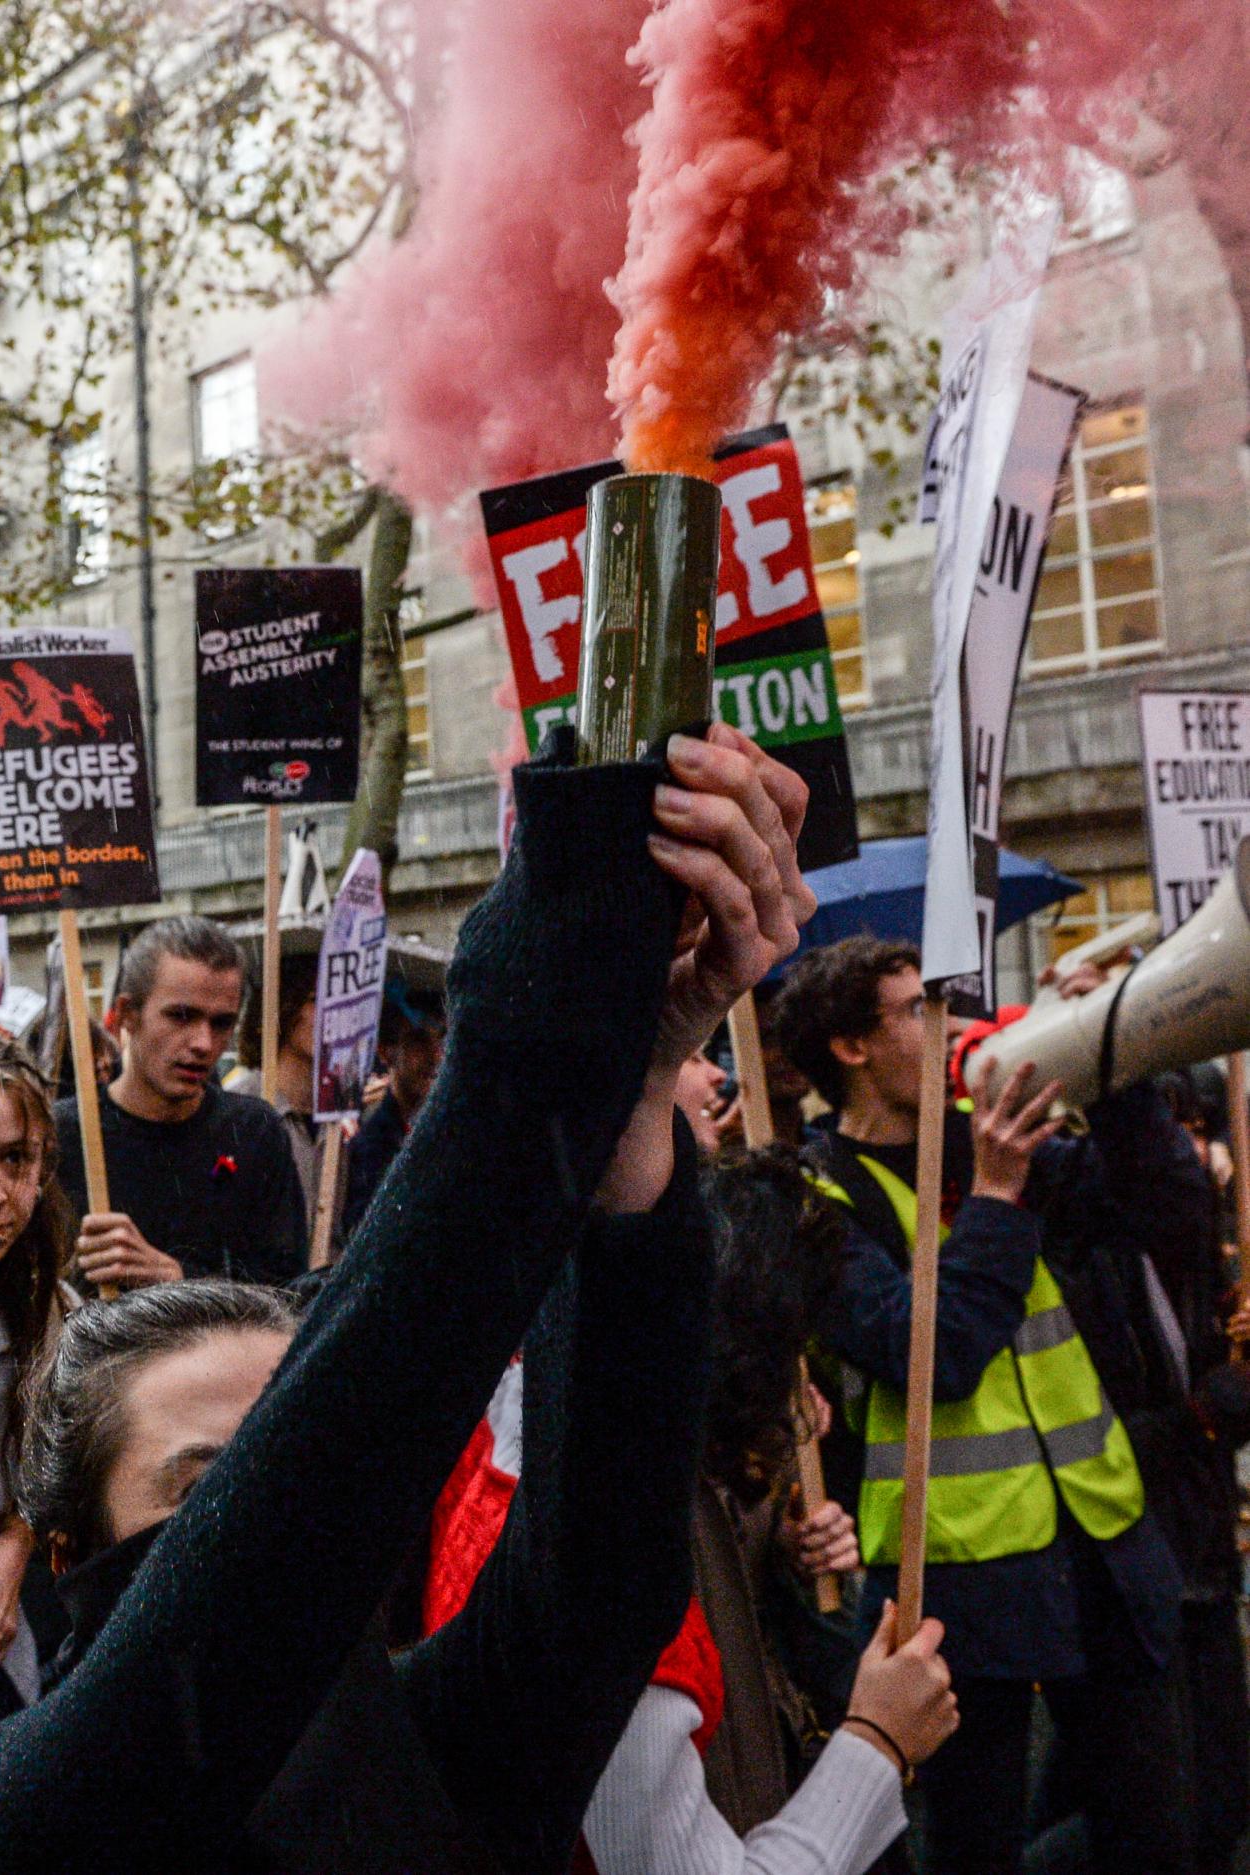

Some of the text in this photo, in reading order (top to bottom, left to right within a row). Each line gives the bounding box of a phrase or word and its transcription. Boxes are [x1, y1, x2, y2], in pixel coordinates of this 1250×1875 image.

[43, 632, 108, 652] Worker
[230, 611, 322, 647] STUDENT
[202, 637, 303, 675] ASSEMBLY
[229, 648, 337, 688] AUSTERITY
[1181, 701, 1241, 750] FREE
[28, 847, 60, 868] the
[3, 871, 54, 892] them
[59, 866, 79, 886] in
